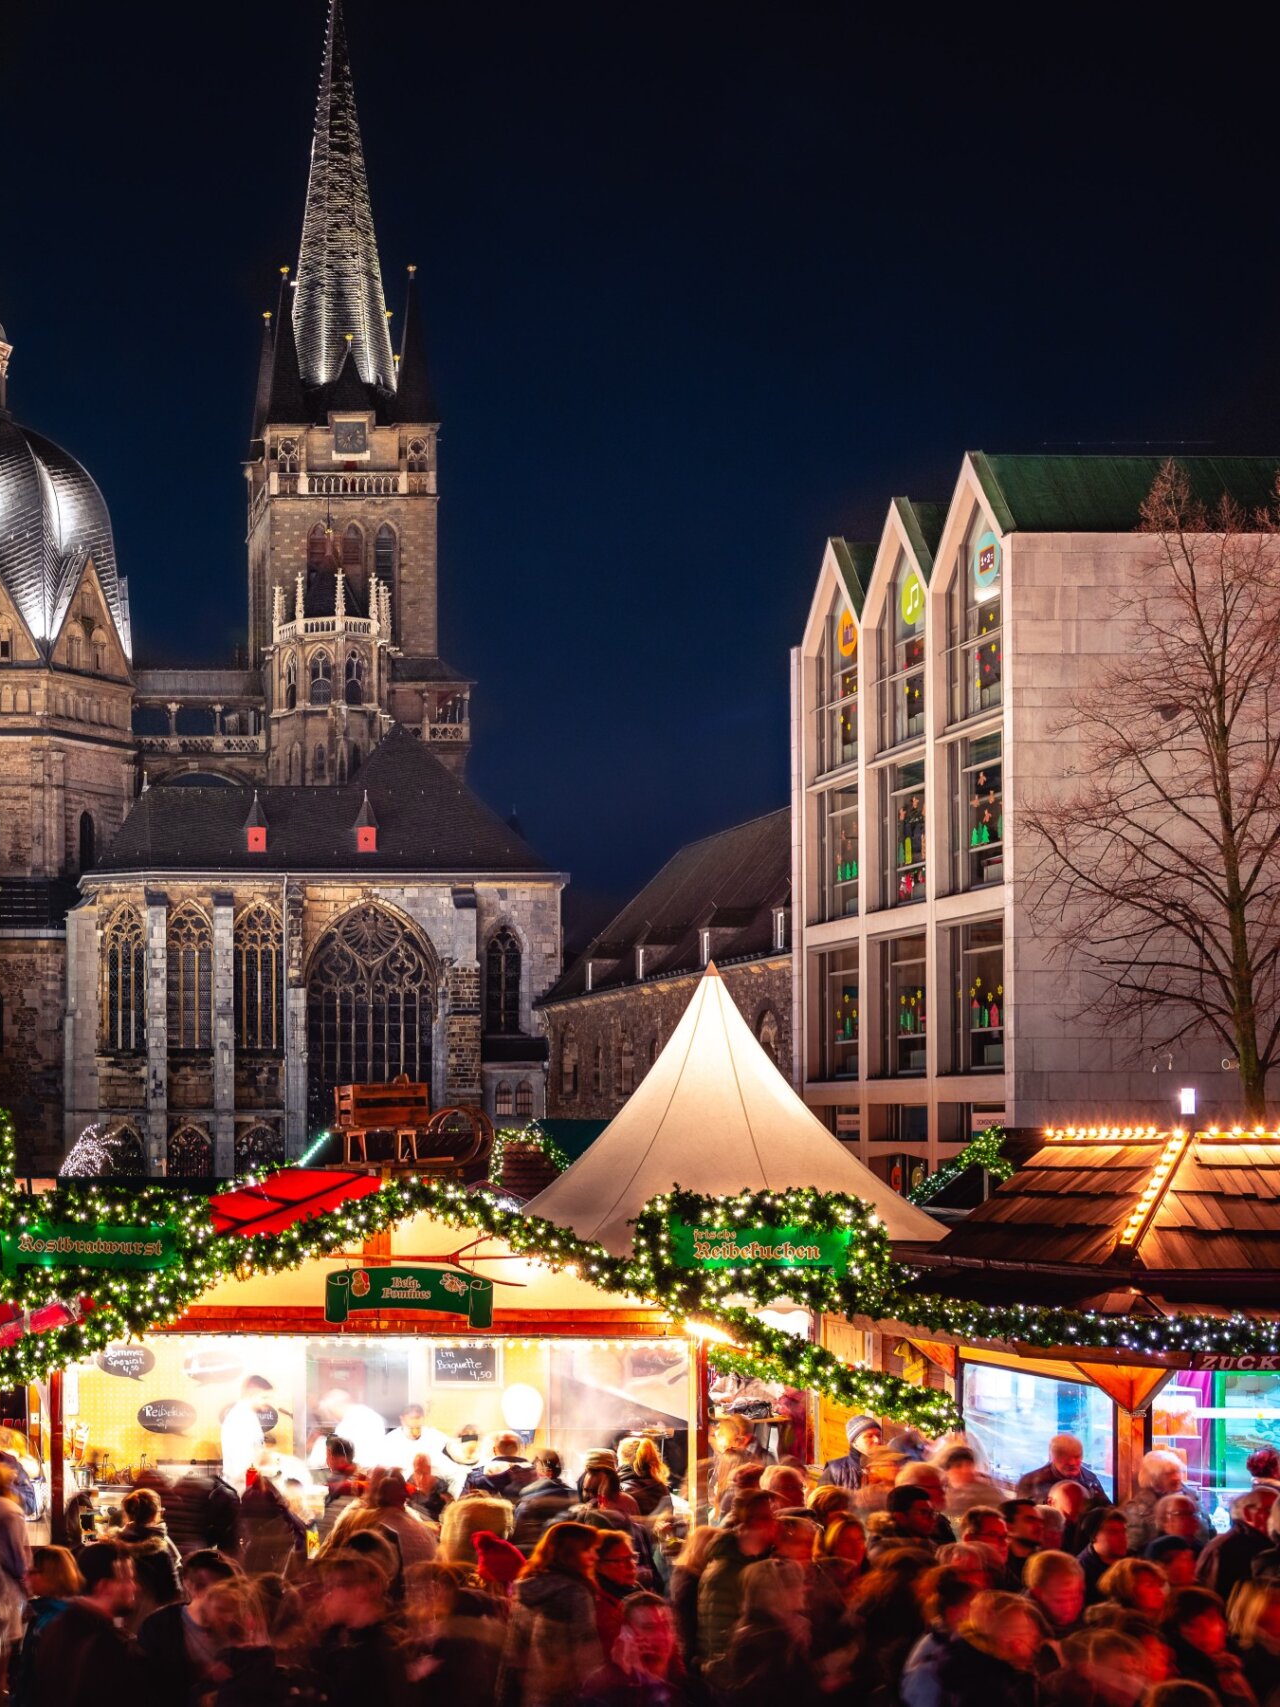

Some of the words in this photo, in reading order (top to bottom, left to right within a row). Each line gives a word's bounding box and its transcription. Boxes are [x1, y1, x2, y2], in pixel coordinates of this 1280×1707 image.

[693, 1228, 737, 1242] frische
[17, 1235, 163, 1256] Rostbratwurst
[693, 1240, 821, 1263] Reibekuchen
[391, 1276, 421, 1290] Belg.
[436, 1358, 483, 1374] Baguette
[469, 1370, 493, 1381] 4,50
